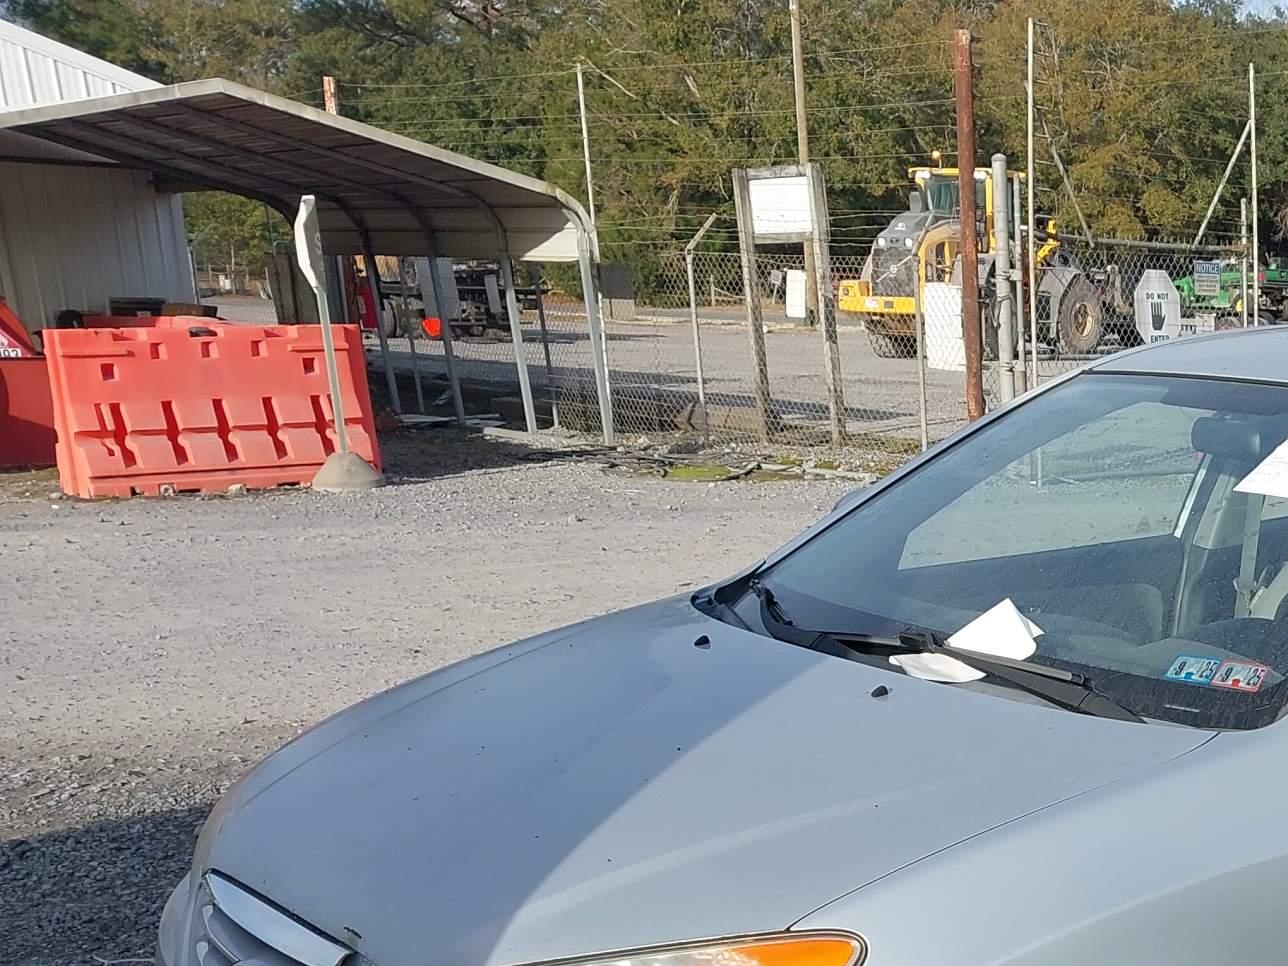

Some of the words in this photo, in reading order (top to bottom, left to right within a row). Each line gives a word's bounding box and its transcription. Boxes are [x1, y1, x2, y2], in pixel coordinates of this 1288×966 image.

[1196, 263, 1219, 273] NOTICE
[1145, 292, 1155, 300] DO
[1157, 292, 1169, 300] NOT
[1174, 661, 1187, 676] 9
[1199, 661, 1219, 680] 25
[1221, 667, 1234, 683] 9
[1246, 668, 1267, 686] 25
